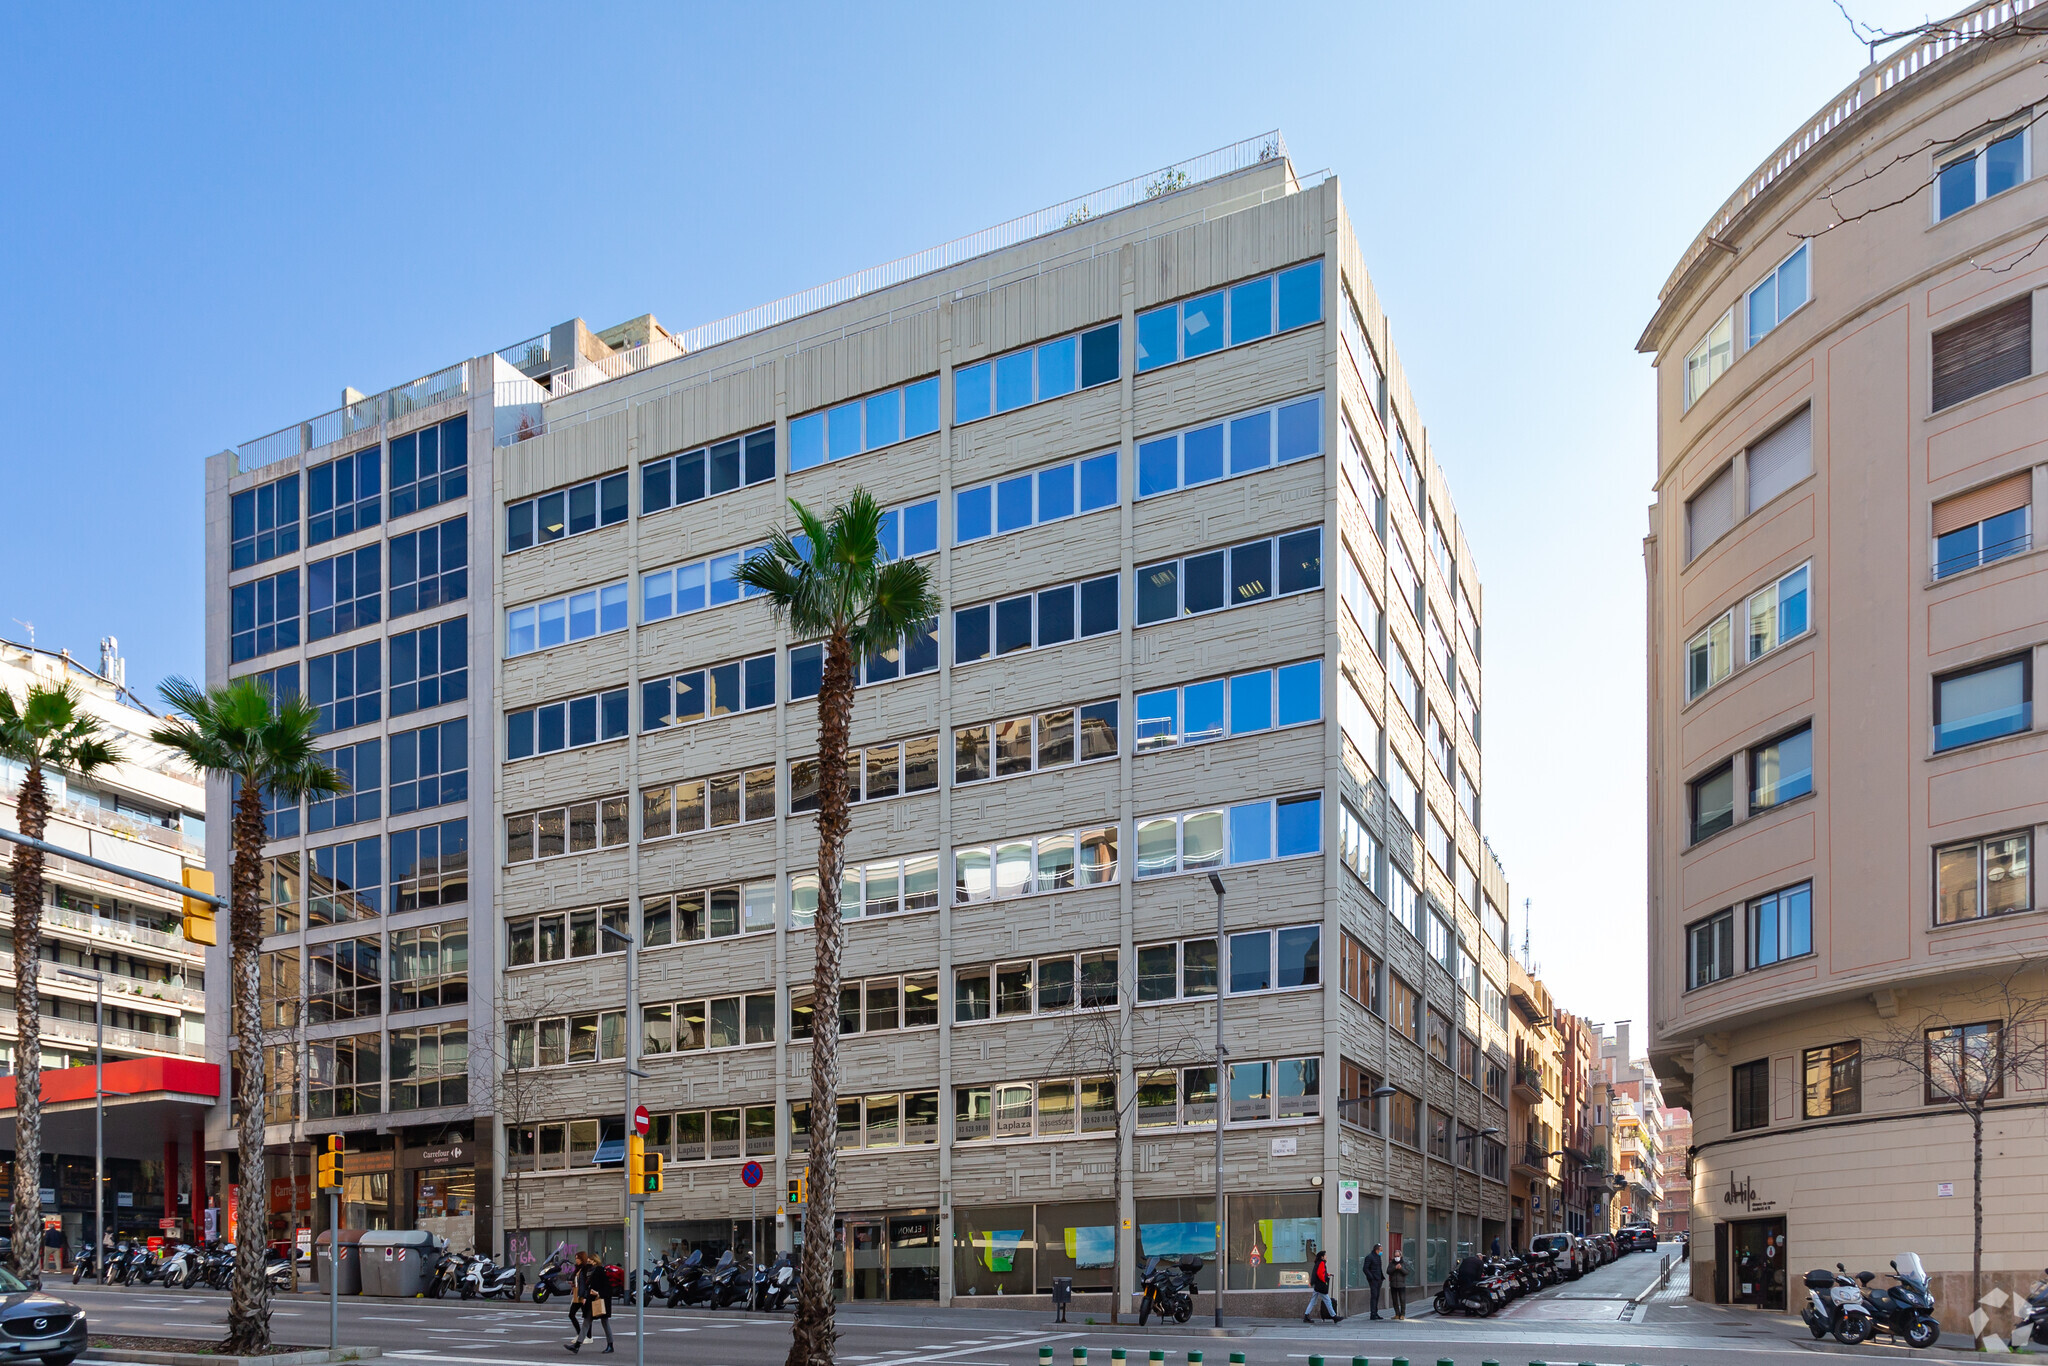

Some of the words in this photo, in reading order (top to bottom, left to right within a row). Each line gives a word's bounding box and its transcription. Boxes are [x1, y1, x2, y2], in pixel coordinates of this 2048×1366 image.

[997, 1121, 1031, 1131] Laplaza
[1040, 1119, 1073, 1127] assessors
[422, 1149, 450, 1159] Carrefour
[678, 1145, 705, 1155] Laplaza
[712, 1143, 740, 1151] assessors
[509, 1249, 536, 1266] VGA
